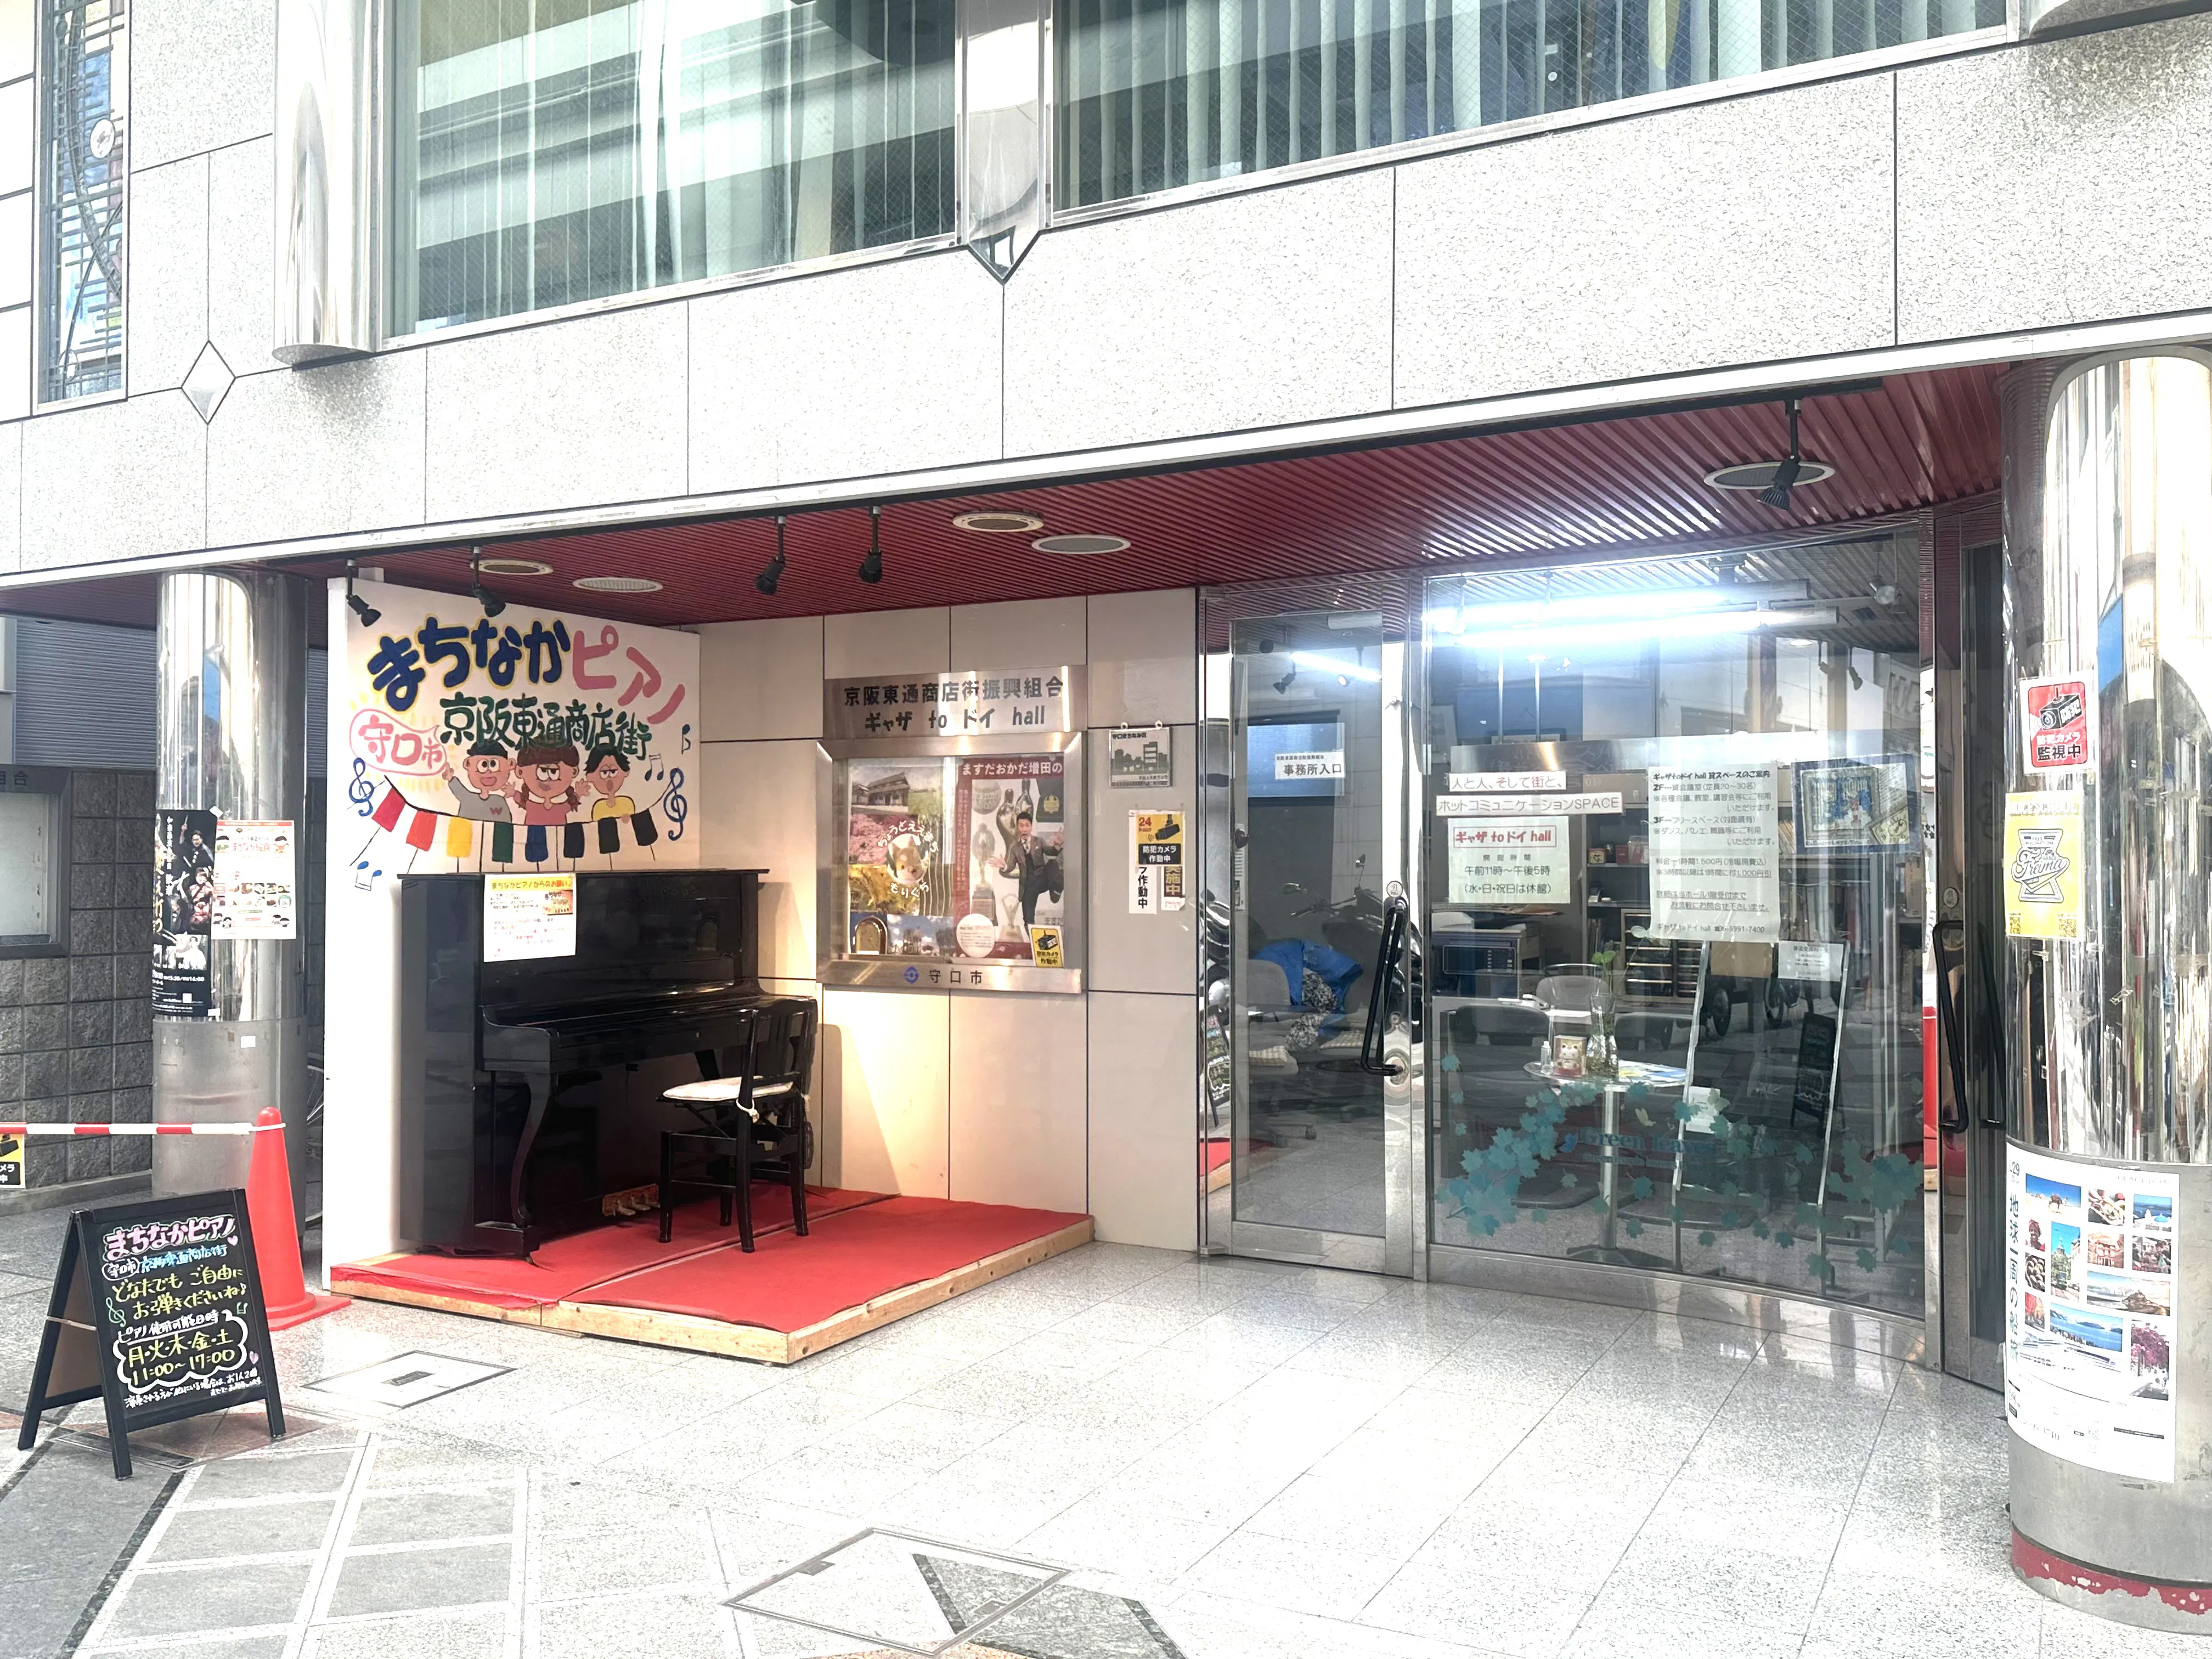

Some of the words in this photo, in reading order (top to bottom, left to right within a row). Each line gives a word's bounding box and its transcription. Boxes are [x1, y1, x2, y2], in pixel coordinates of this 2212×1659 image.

[367, 614, 685, 725] まちなかピアノ
[844, 676, 1063, 706] 京阪東通商店街振興組合
[865, 712, 912, 731] ギャザ
[928, 710, 947, 729] to
[964, 708, 995, 729] ドイ
[1012, 706, 1045, 725] hall
[439, 692, 652, 761] 京阪東通商店街
[359, 715, 443, 770] 守口市
[2036, 731, 2081, 746] 防犯カメラ
[2038, 743, 2081, 761] 監視中
[963, 761, 1063, 775] ますだおかだ増田の
[1283, 763, 1342, 776] 事務所入口
[1452, 775, 1562, 789] 人と人、そして街と、
[1438, 797, 1619, 812] ホットコミュニケーションSPACE
[1138, 817, 1152, 827] 24
[1456, 831, 1487, 843] ギャザ
[1491, 832, 1504, 842] to
[1508, 831, 1527, 843] ドイ
[1531, 830, 1551, 842] hall
[1143, 845, 1177, 854] 防犯カメラ
[1149, 855, 1171, 863] 作動中
[1464, 865, 1551, 876] 午前11時～午後5時
[929, 969, 983, 985] 守口市
[1579, 1127, 1646, 1150] Green
[106, 1215, 236, 1261] まちなかピアノ
[111, 1273, 183, 1303] どなたでも
[190, 1264, 243, 1285] ご自由に
